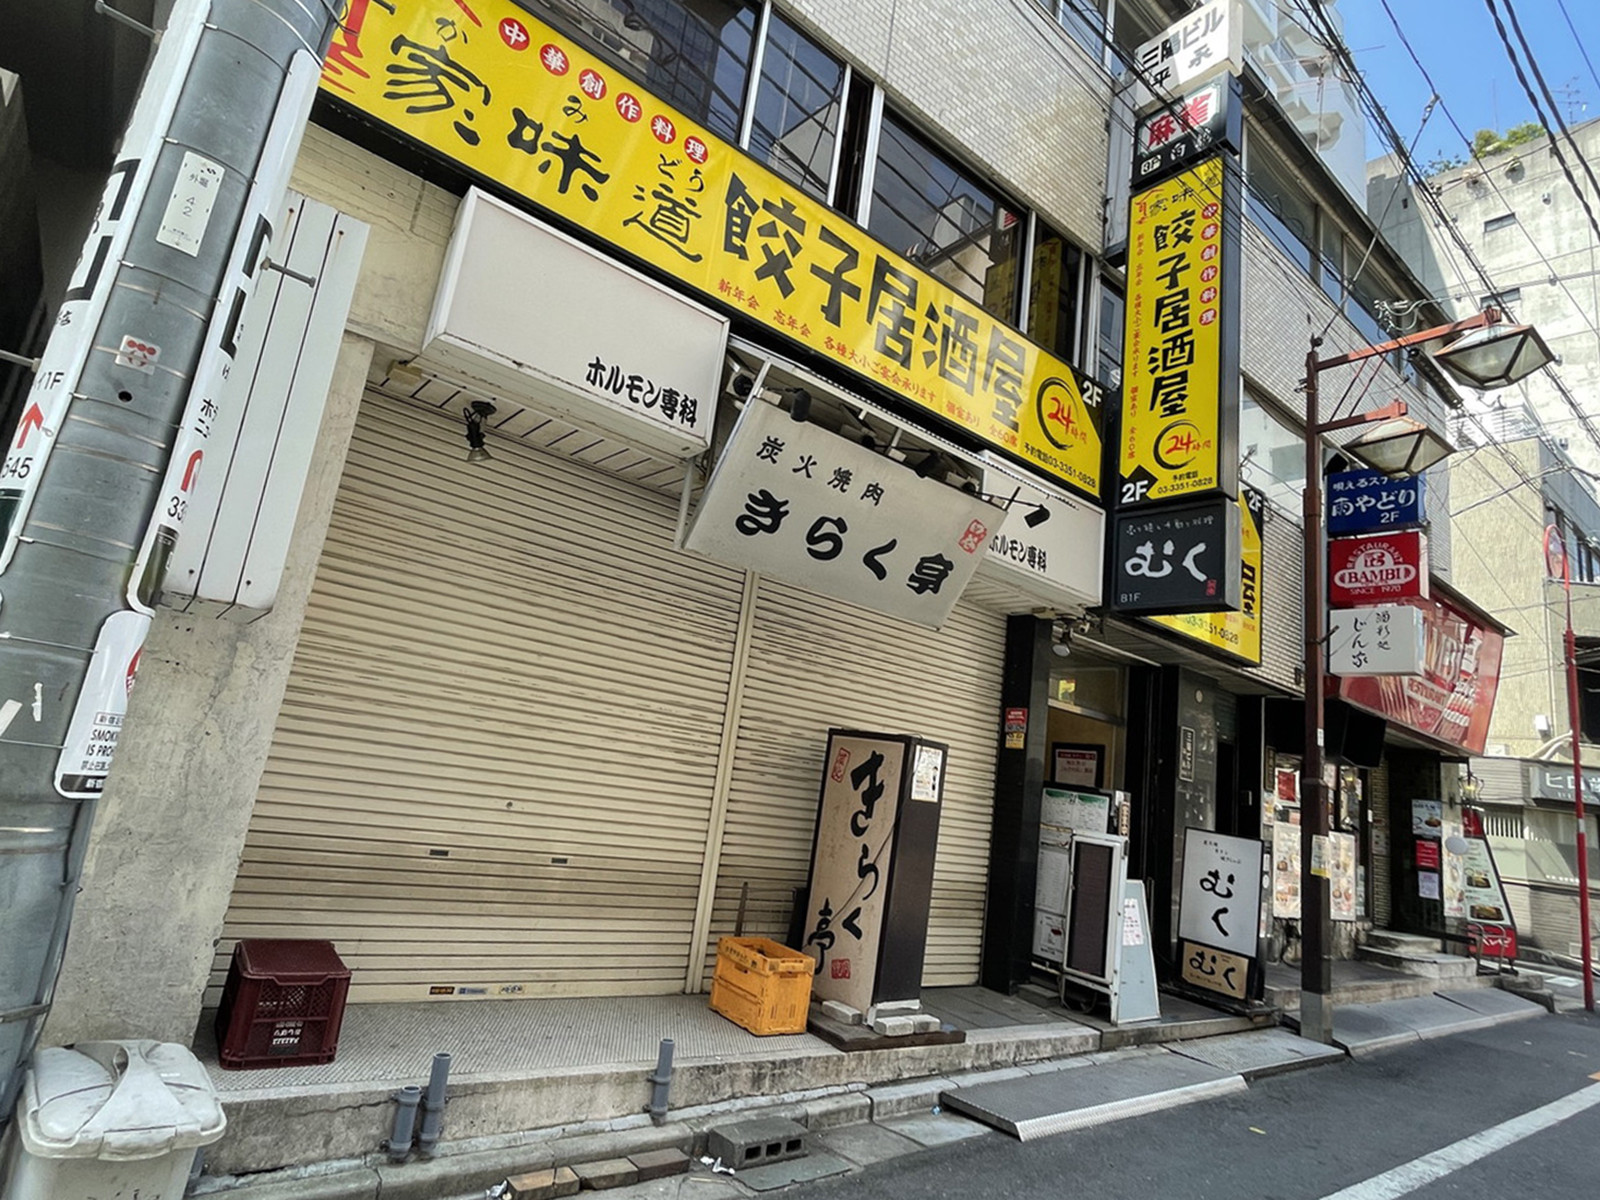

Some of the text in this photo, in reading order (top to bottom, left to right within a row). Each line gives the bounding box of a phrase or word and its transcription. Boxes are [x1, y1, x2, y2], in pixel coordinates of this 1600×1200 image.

[501, 22, 708, 164] 中華創作料理
[718, 278, 761, 311] 新年会
[773, 308, 811, 339] 忘年会
[723, 172, 1027, 433] 餃子居酒屋
[1148, 209, 1197, 418] 餃子居酒屋
[586, 356, 698, 428] ホルモン専科
[1082, 380, 1103, 408] 2F
[756, 436, 885, 506] 炭火焼肉
[1121, 480, 1149, 504] 2F
[1248, 489, 1262, 513] 2F
[1331, 489, 1416, 517] 雨やどり
[1380, 511, 1400, 524] 2F
[1125, 540, 1208, 582] むく
[1346, 542, 1404, 569] RESTAURANT
[1348, 567, 1402, 584] BAMBI
[1120, 592, 1141, 603] B1F
[1350, 586, 1375, 595] SINCE
[86, 744, 96, 756] IS
[1199, 869, 1235, 937] むく
[1189, 951, 1236, 990] むく
